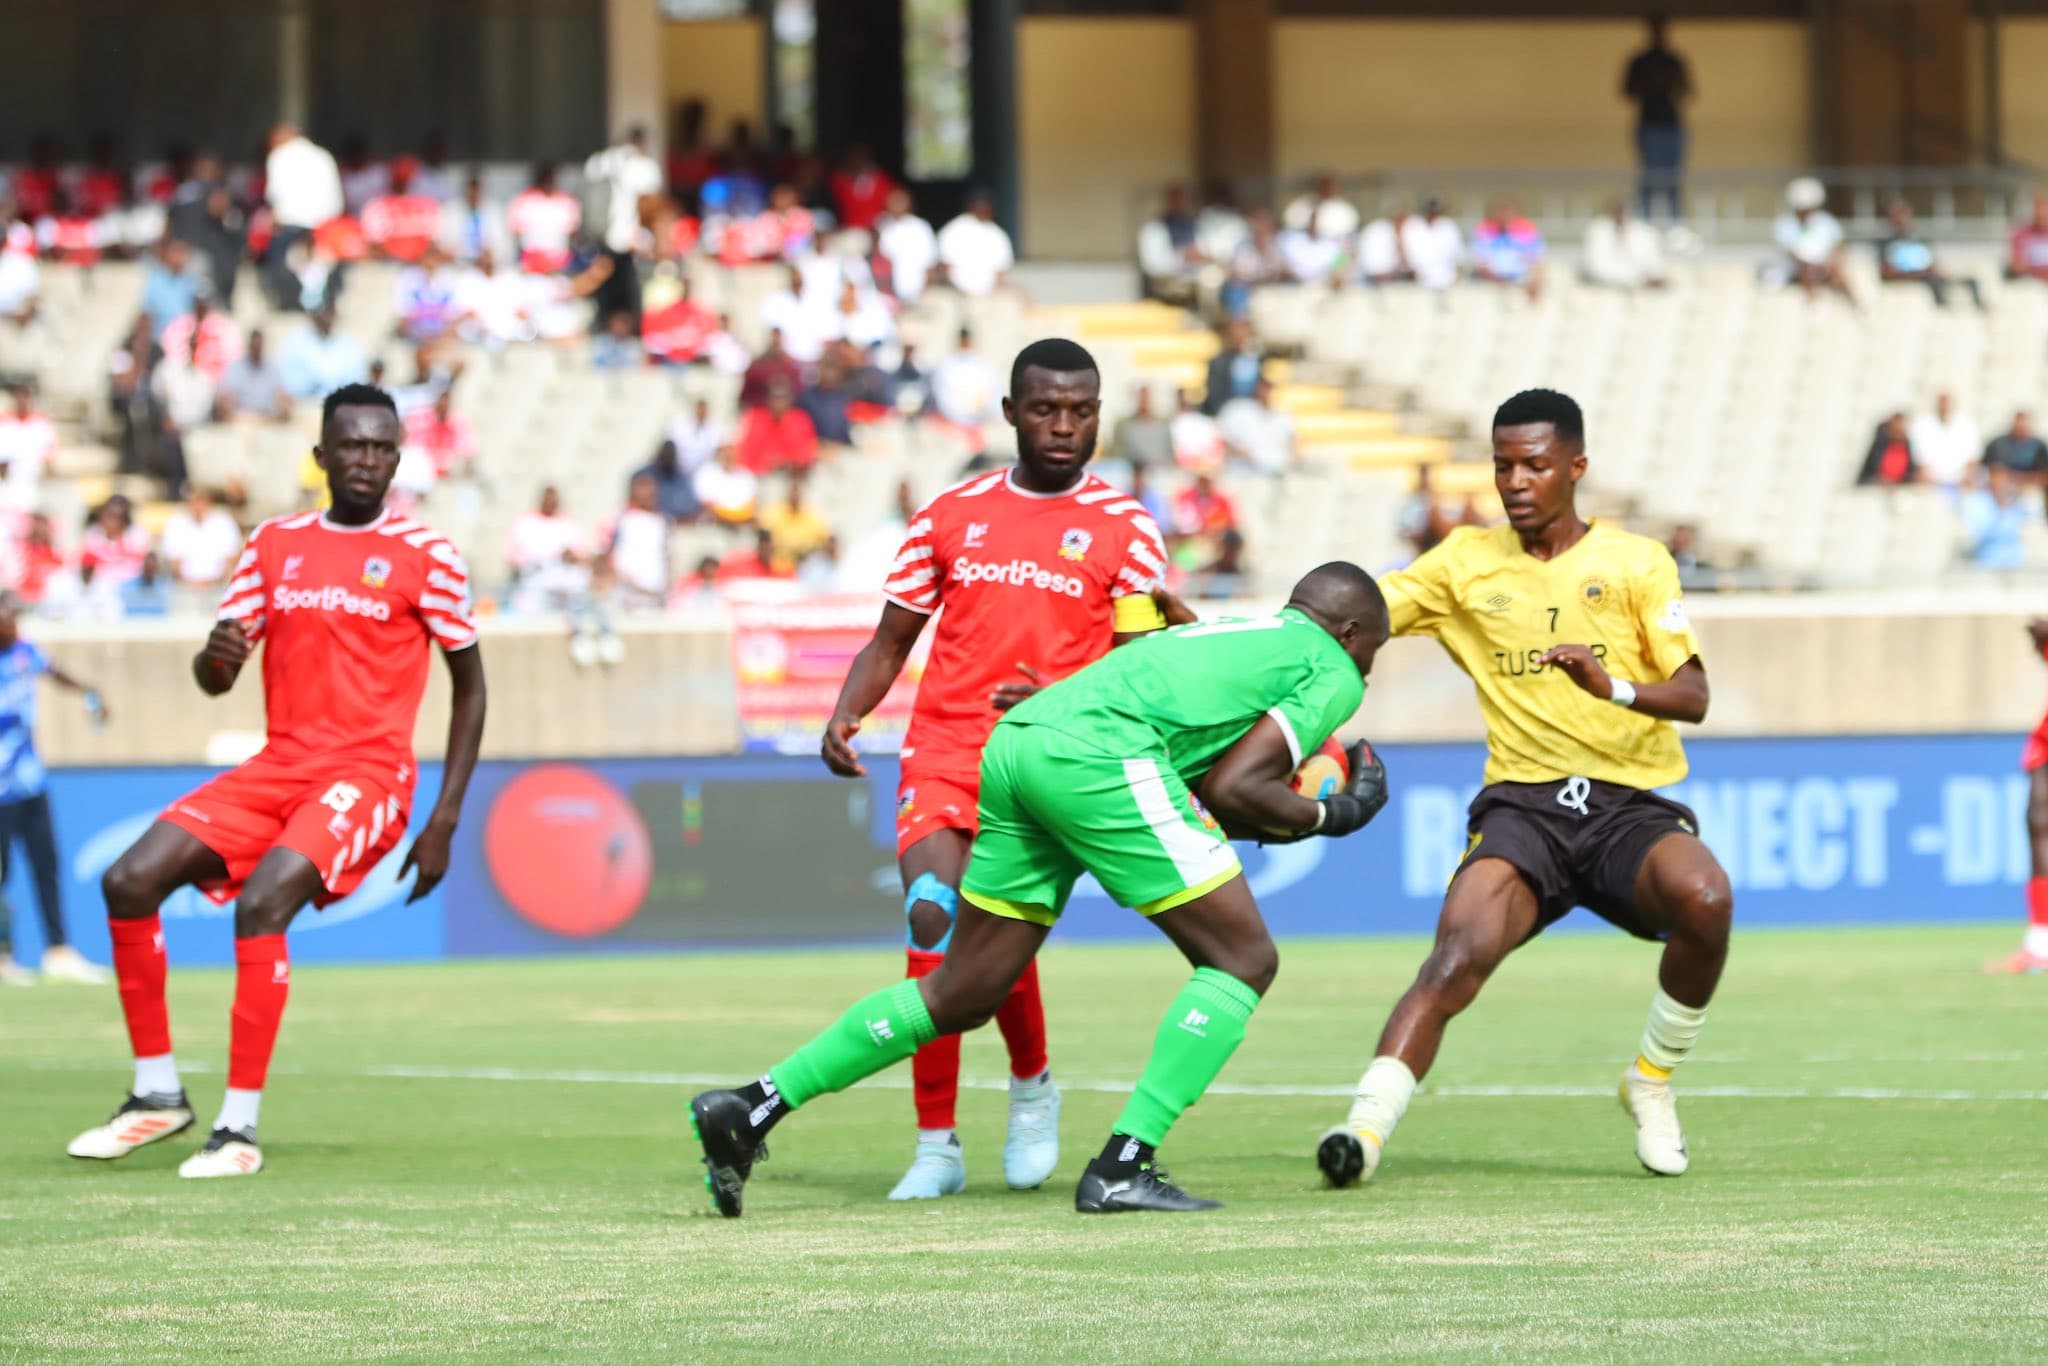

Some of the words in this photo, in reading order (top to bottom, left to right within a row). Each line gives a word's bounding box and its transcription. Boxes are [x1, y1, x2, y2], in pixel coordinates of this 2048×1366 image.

[952, 556, 1084, 598] SportPesa
[272, 585, 391, 622] SportPesa
[1546, 607, 1560, 633] 7
[1495, 643, 1607, 676] TUSR
